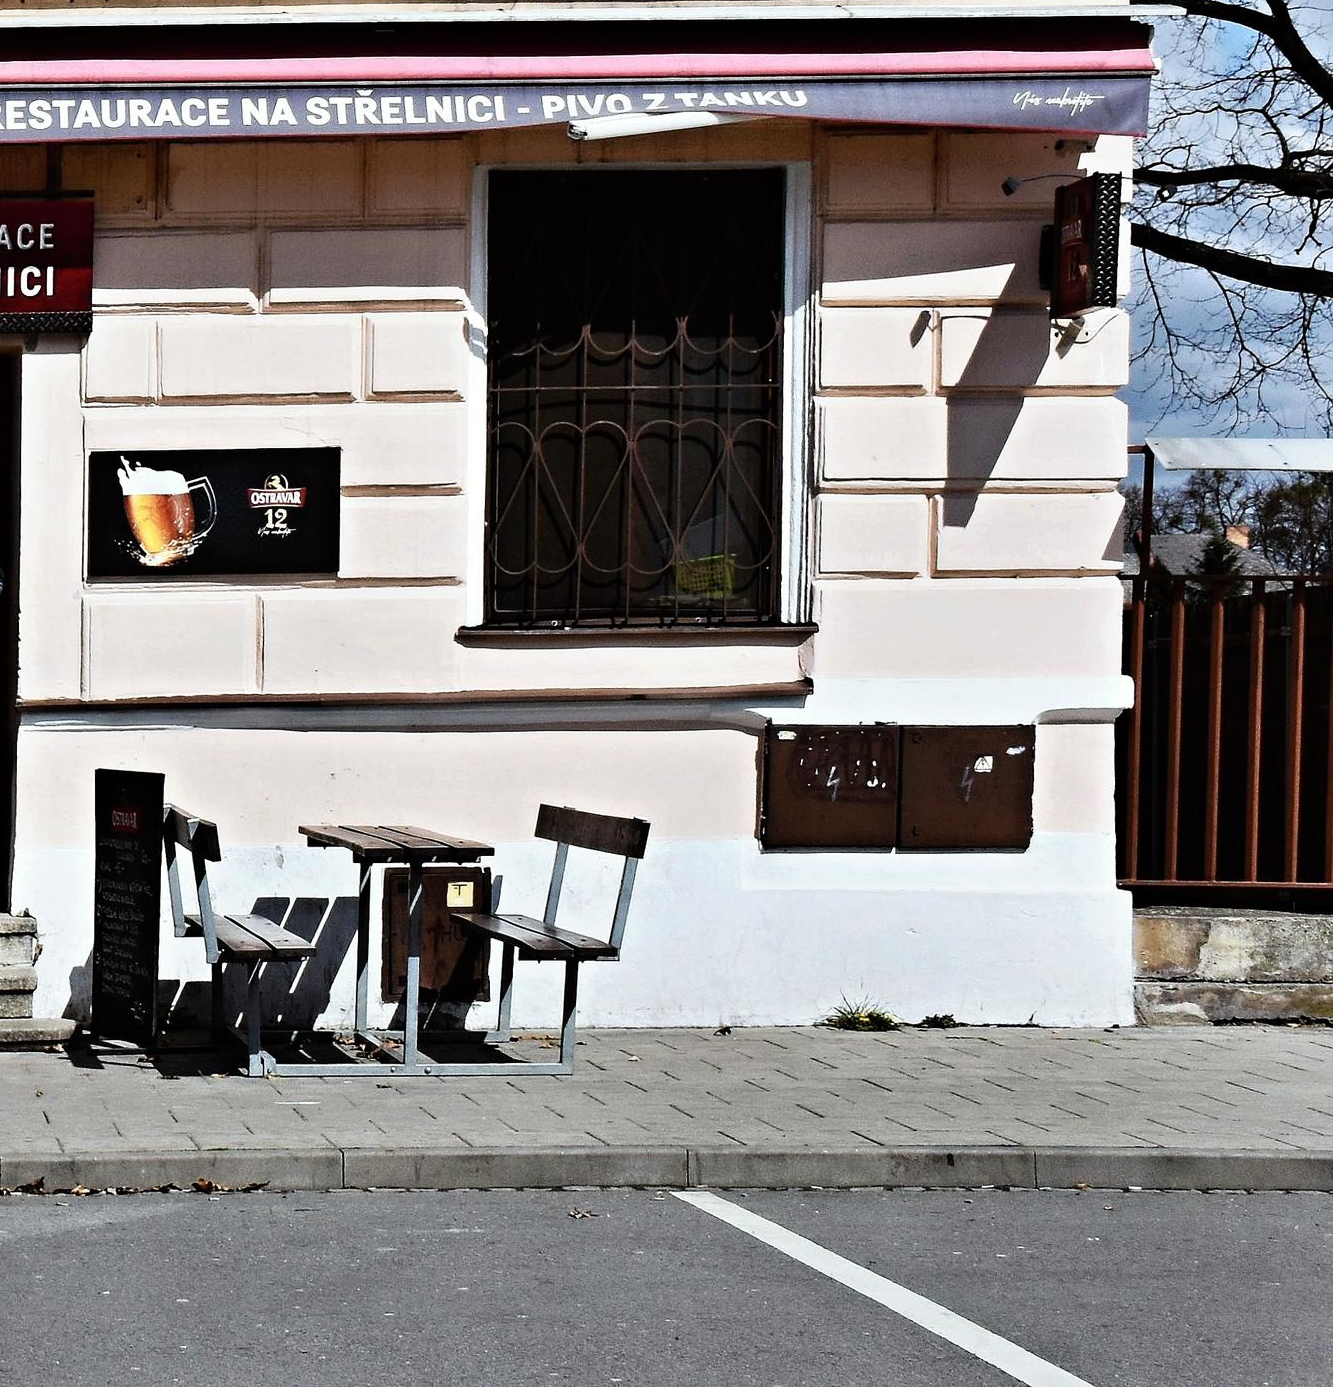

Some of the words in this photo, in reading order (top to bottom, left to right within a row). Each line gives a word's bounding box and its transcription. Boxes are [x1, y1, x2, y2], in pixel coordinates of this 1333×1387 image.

[241, 97, 298, 127] NA
[306, 89, 506, 126] STŘELNICI
[542, 94, 632, 119] PIVO
[642, 93, 670, 111] Z
[675, 90, 809, 108] TANKU
[250, 490, 301, 505] OSTRAVAR
[264, 508, 288, 529] 12
